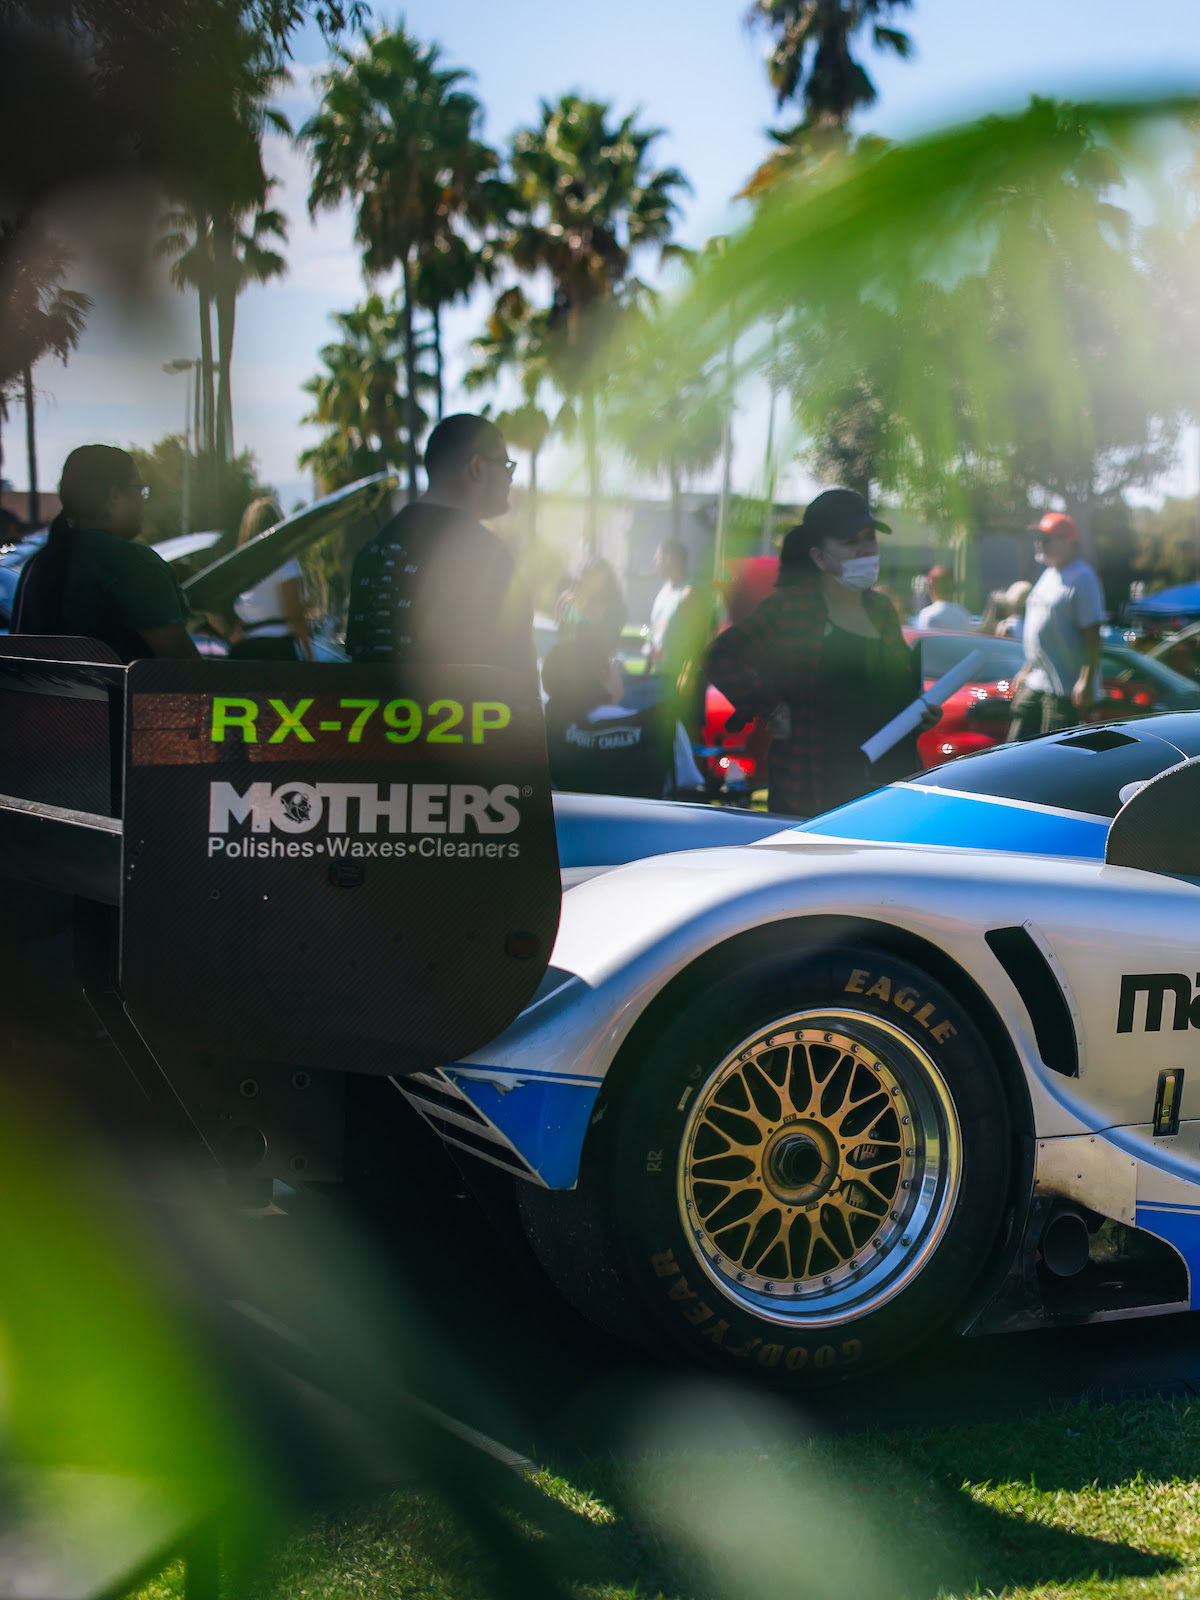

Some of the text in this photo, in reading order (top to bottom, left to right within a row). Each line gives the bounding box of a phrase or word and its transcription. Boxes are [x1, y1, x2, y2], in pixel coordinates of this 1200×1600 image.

[211, 697, 511, 744] RX-792P
[209, 781, 520, 834] MOTHERS
[844, 969, 957, 1044] EAGLE
